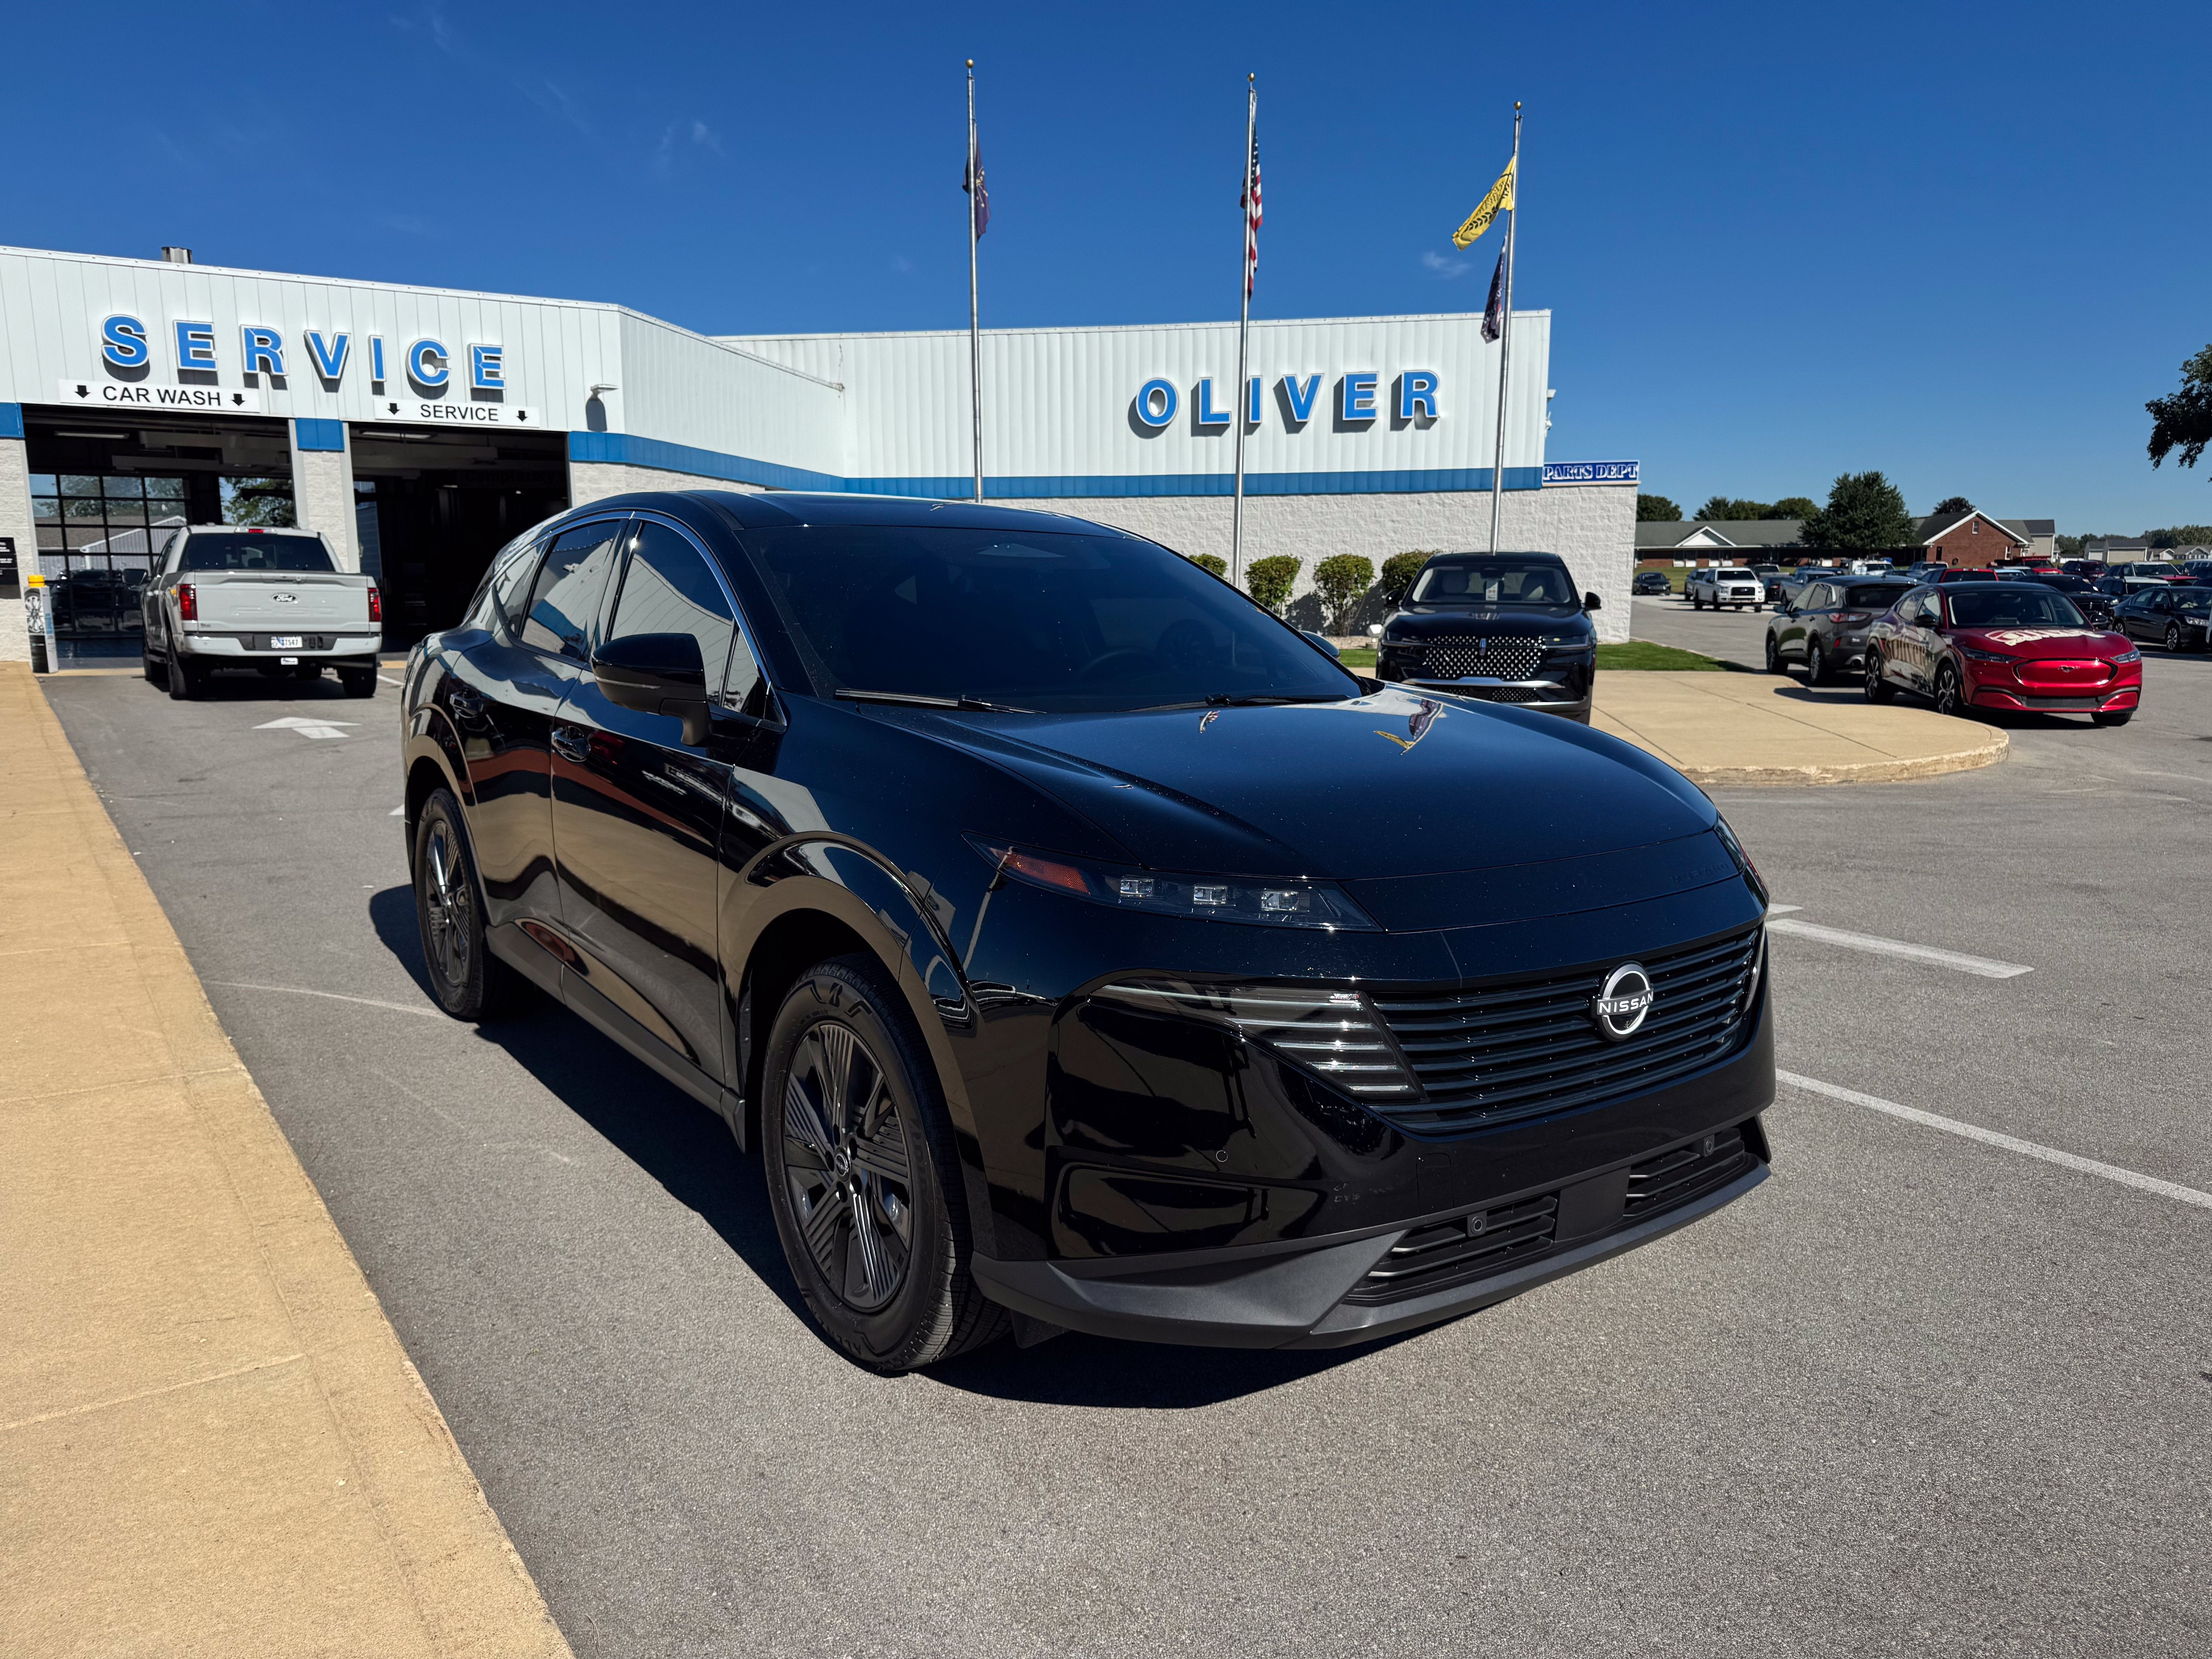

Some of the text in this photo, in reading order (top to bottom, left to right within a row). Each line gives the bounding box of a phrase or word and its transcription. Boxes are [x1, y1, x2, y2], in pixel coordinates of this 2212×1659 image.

[101, 314, 506, 390] SERVICE
[103, 386, 221, 406] CAR WASH
[1136, 370, 1439, 426] OLIVER
[420, 405, 499, 421] SERVICE
[1542, 464, 1638, 480] PARTS DEPT
[1599, 991, 1653, 1013] NISSAN
